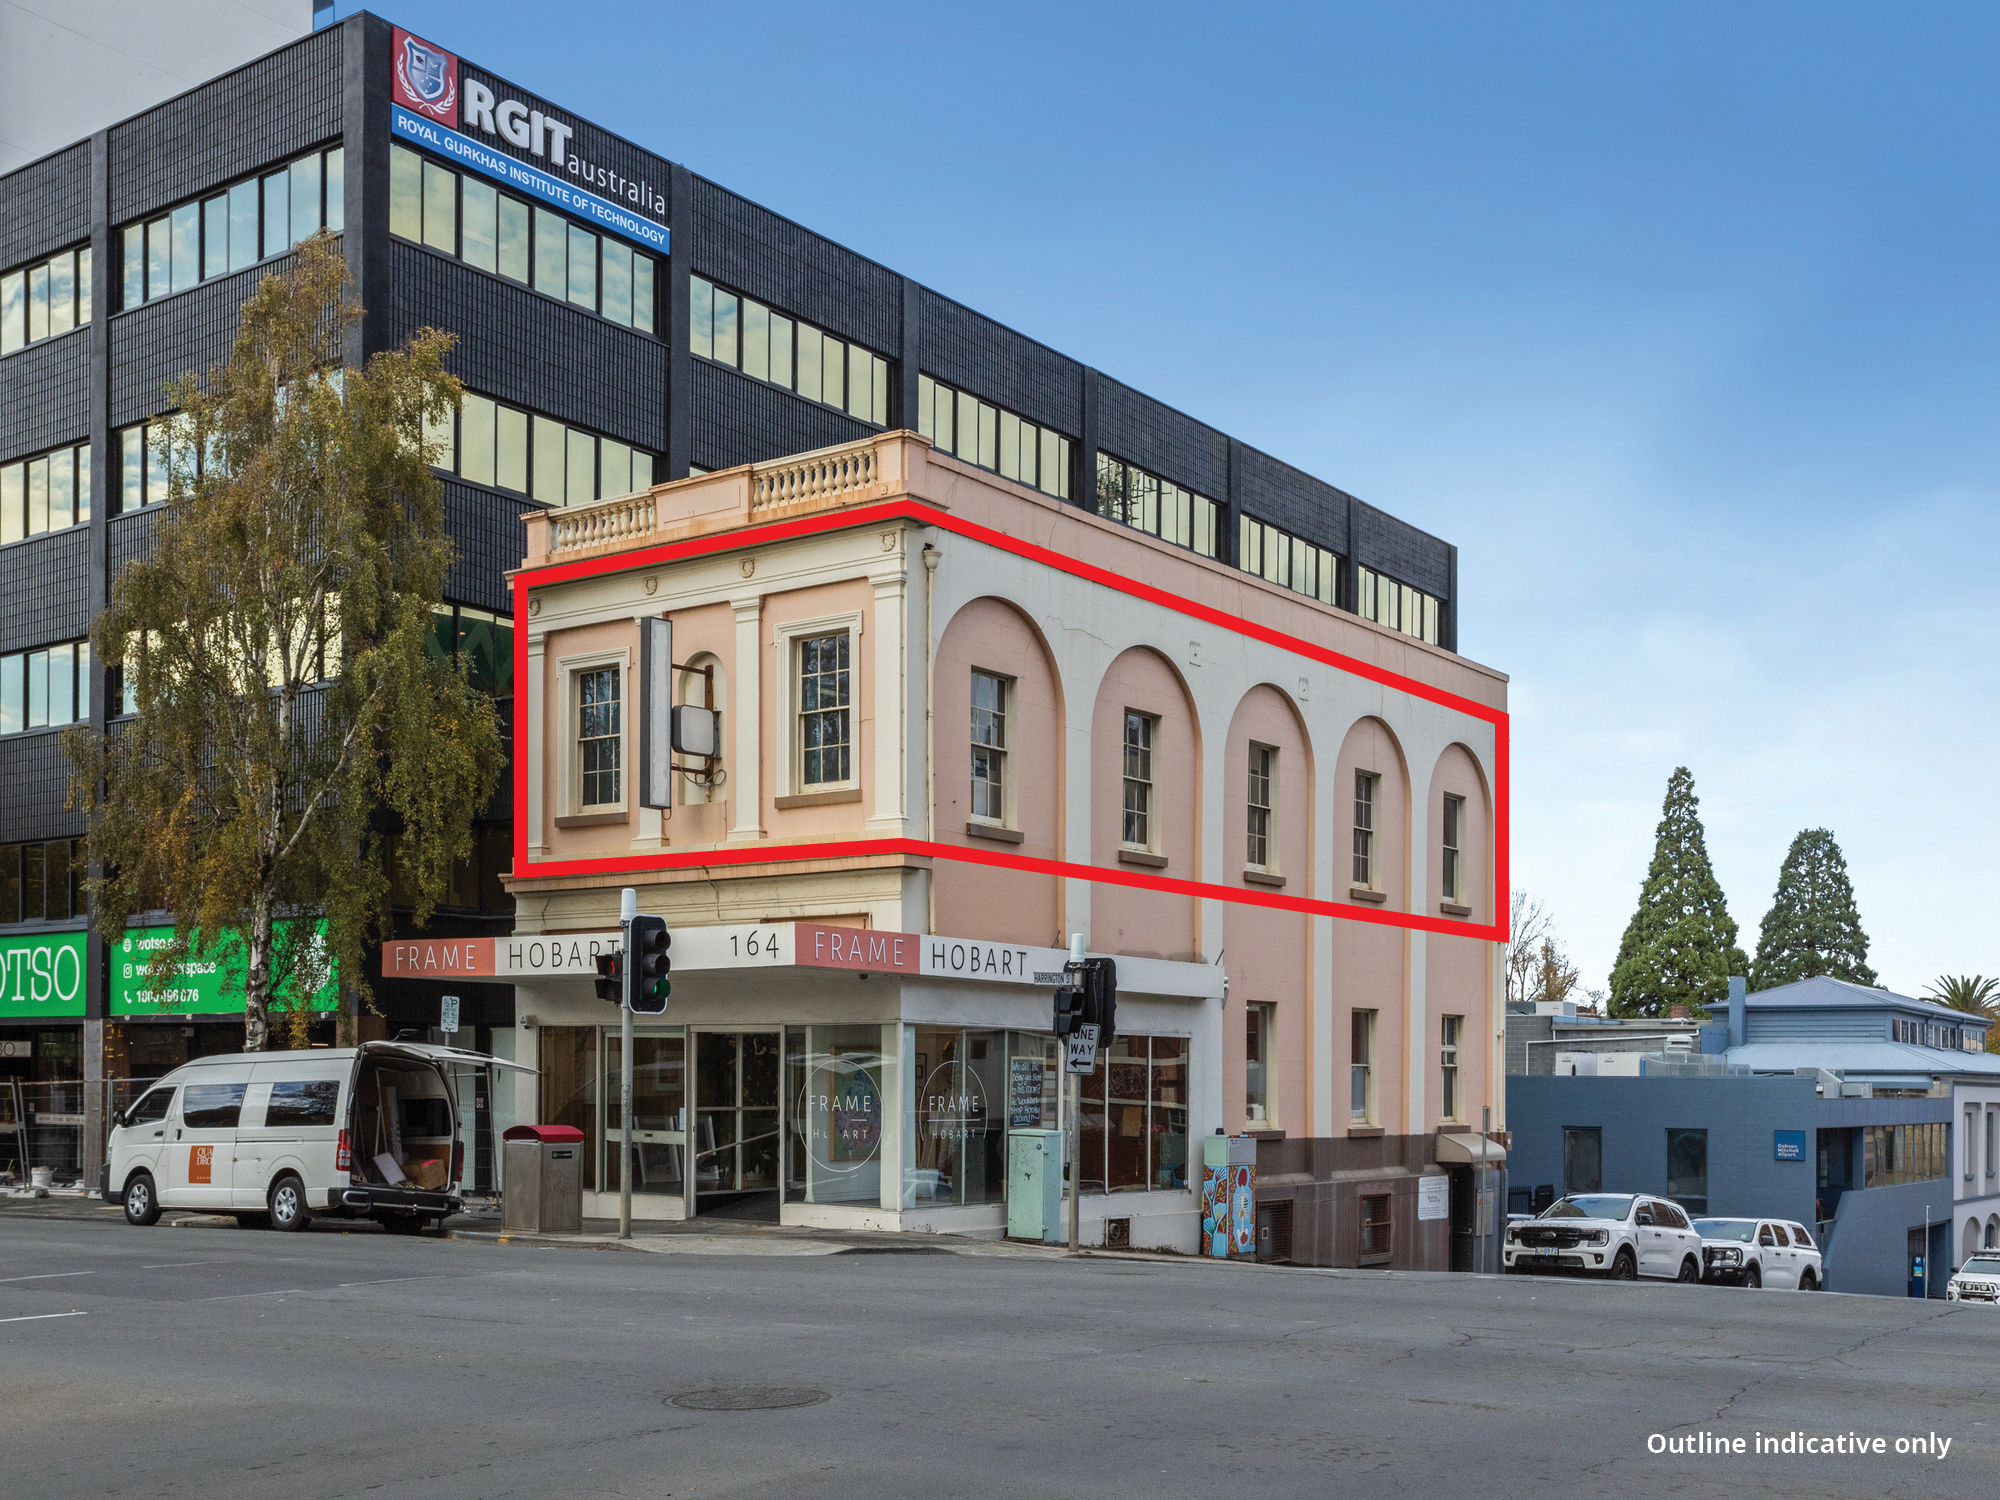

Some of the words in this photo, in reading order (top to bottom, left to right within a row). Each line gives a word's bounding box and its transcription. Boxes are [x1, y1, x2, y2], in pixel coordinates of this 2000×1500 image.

[464, 78, 572, 166] RGIT
[568, 154, 665, 215] australia
[398, 114, 441, 145] ROYAL
[444, 137, 507, 174] GURKHAS
[510, 167, 570, 203] INSTITUTE
[573, 195, 588, 210] OF
[590, 202, 665, 245] TECHNOLOGY
[730, 929, 779, 958] 164
[814, 931, 904, 966] FRAME
[932, 943, 1027, 976] HOBART
[395, 944, 476, 971] FRAME
[0, 945, 80, 1001] TSO
[1034, 973, 1065, 984] HARRINGTON
[1073, 1029, 1095, 1040] ONE
[1070, 1043, 1095, 1056] WAY
[808, 1095, 872, 1113] FRAME
[929, 1096, 979, 1113] FRAME
[932, 1129, 976, 1140] HOBART
